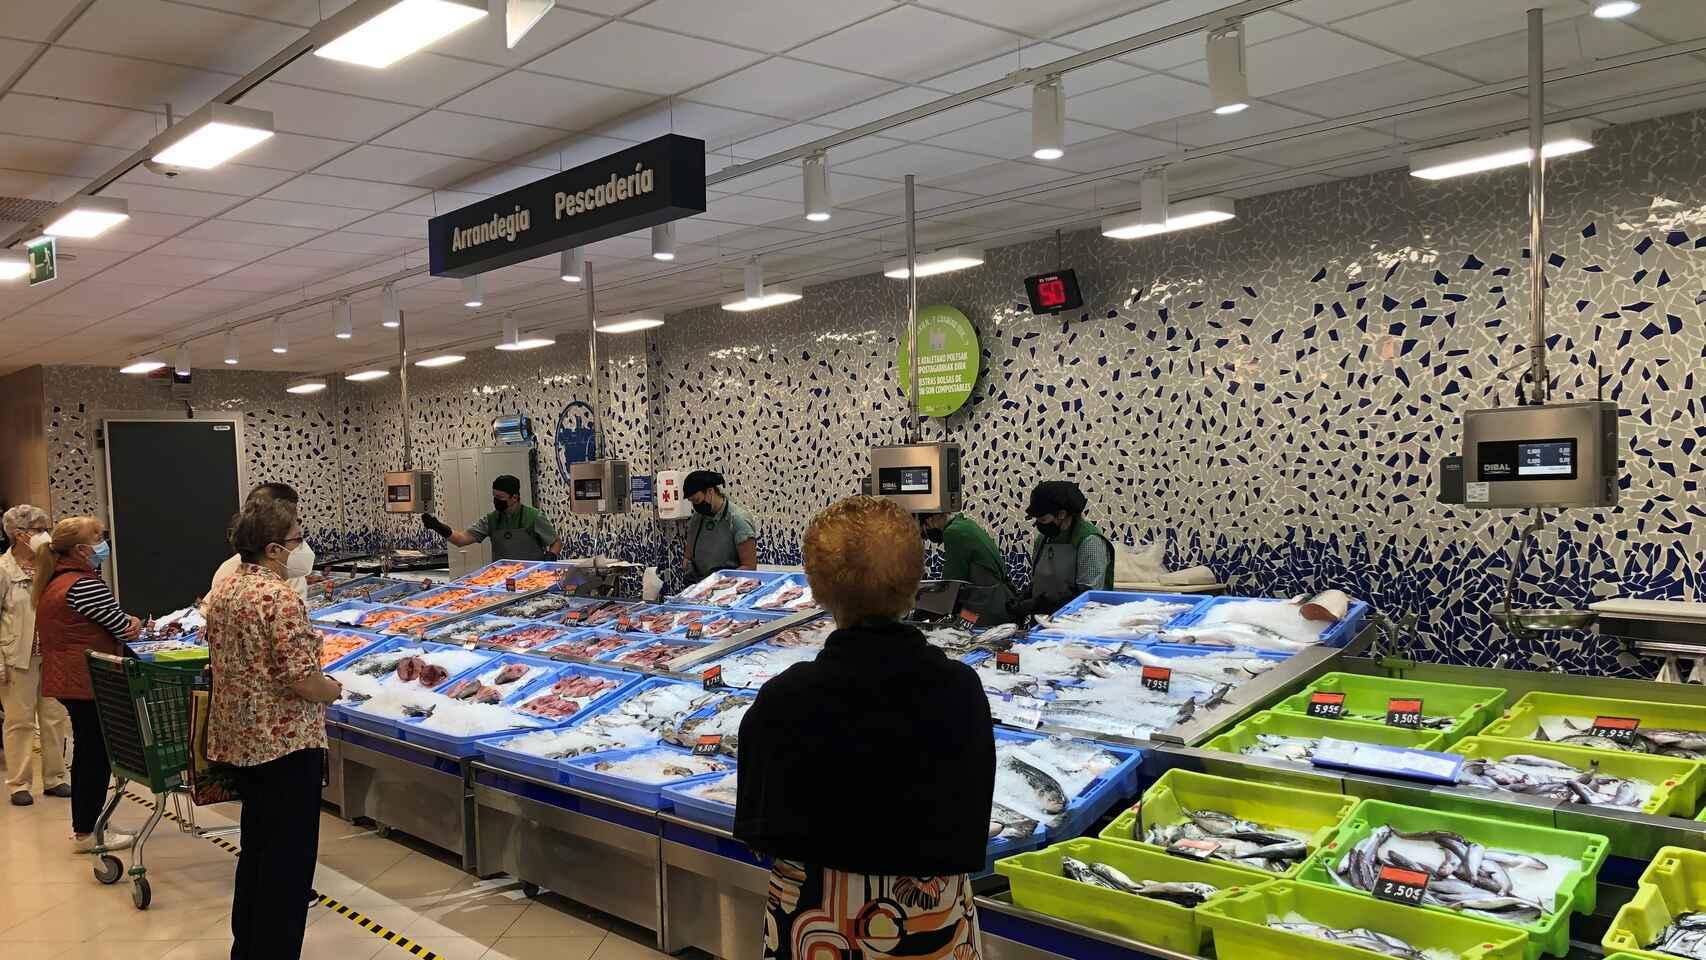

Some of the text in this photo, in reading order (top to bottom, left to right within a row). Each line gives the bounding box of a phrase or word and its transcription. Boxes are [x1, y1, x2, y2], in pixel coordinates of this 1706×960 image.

[451, 162, 654, 252] Arrandegia Pescadería
[918, 362, 954, 374] POSTAGARRIAK
[955, 373, 962, 383] DE
[1483, 463, 1511, 471] DIBAL
[1384, 882, 1422, 901] 2,50€
